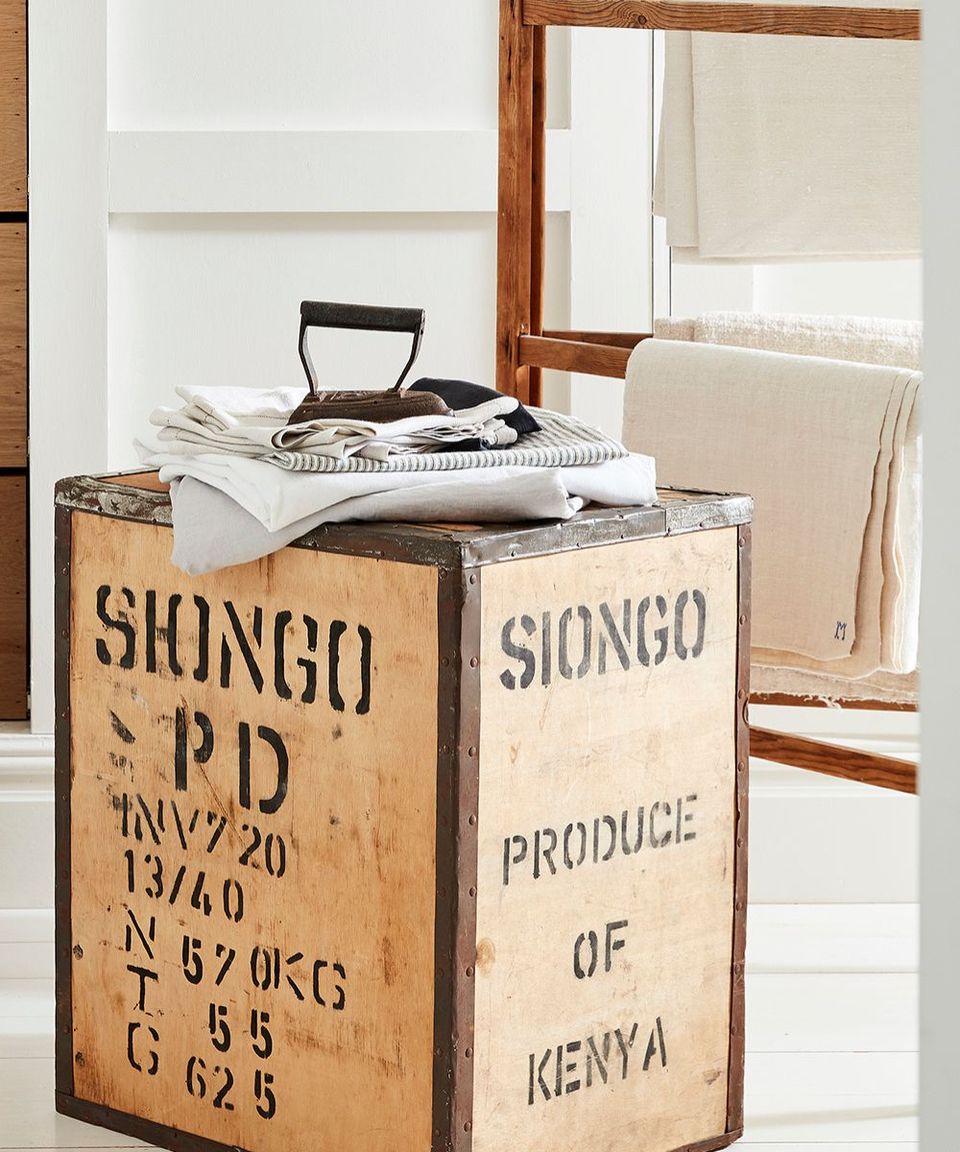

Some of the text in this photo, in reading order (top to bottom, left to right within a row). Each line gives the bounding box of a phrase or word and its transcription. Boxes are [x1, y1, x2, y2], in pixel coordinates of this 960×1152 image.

[499, 589, 707, 691] SIONGO
[502, 794, 698, 886] PRODUCE
[124, 849, 245, 924] 13/40
[125, 909, 156, 960] N
[573, 919, 629, 980] OF
[126, 964, 159, 1012] T
[127, 1022, 160, 1076] G
[527, 1016, 667, 1106] KENYA
